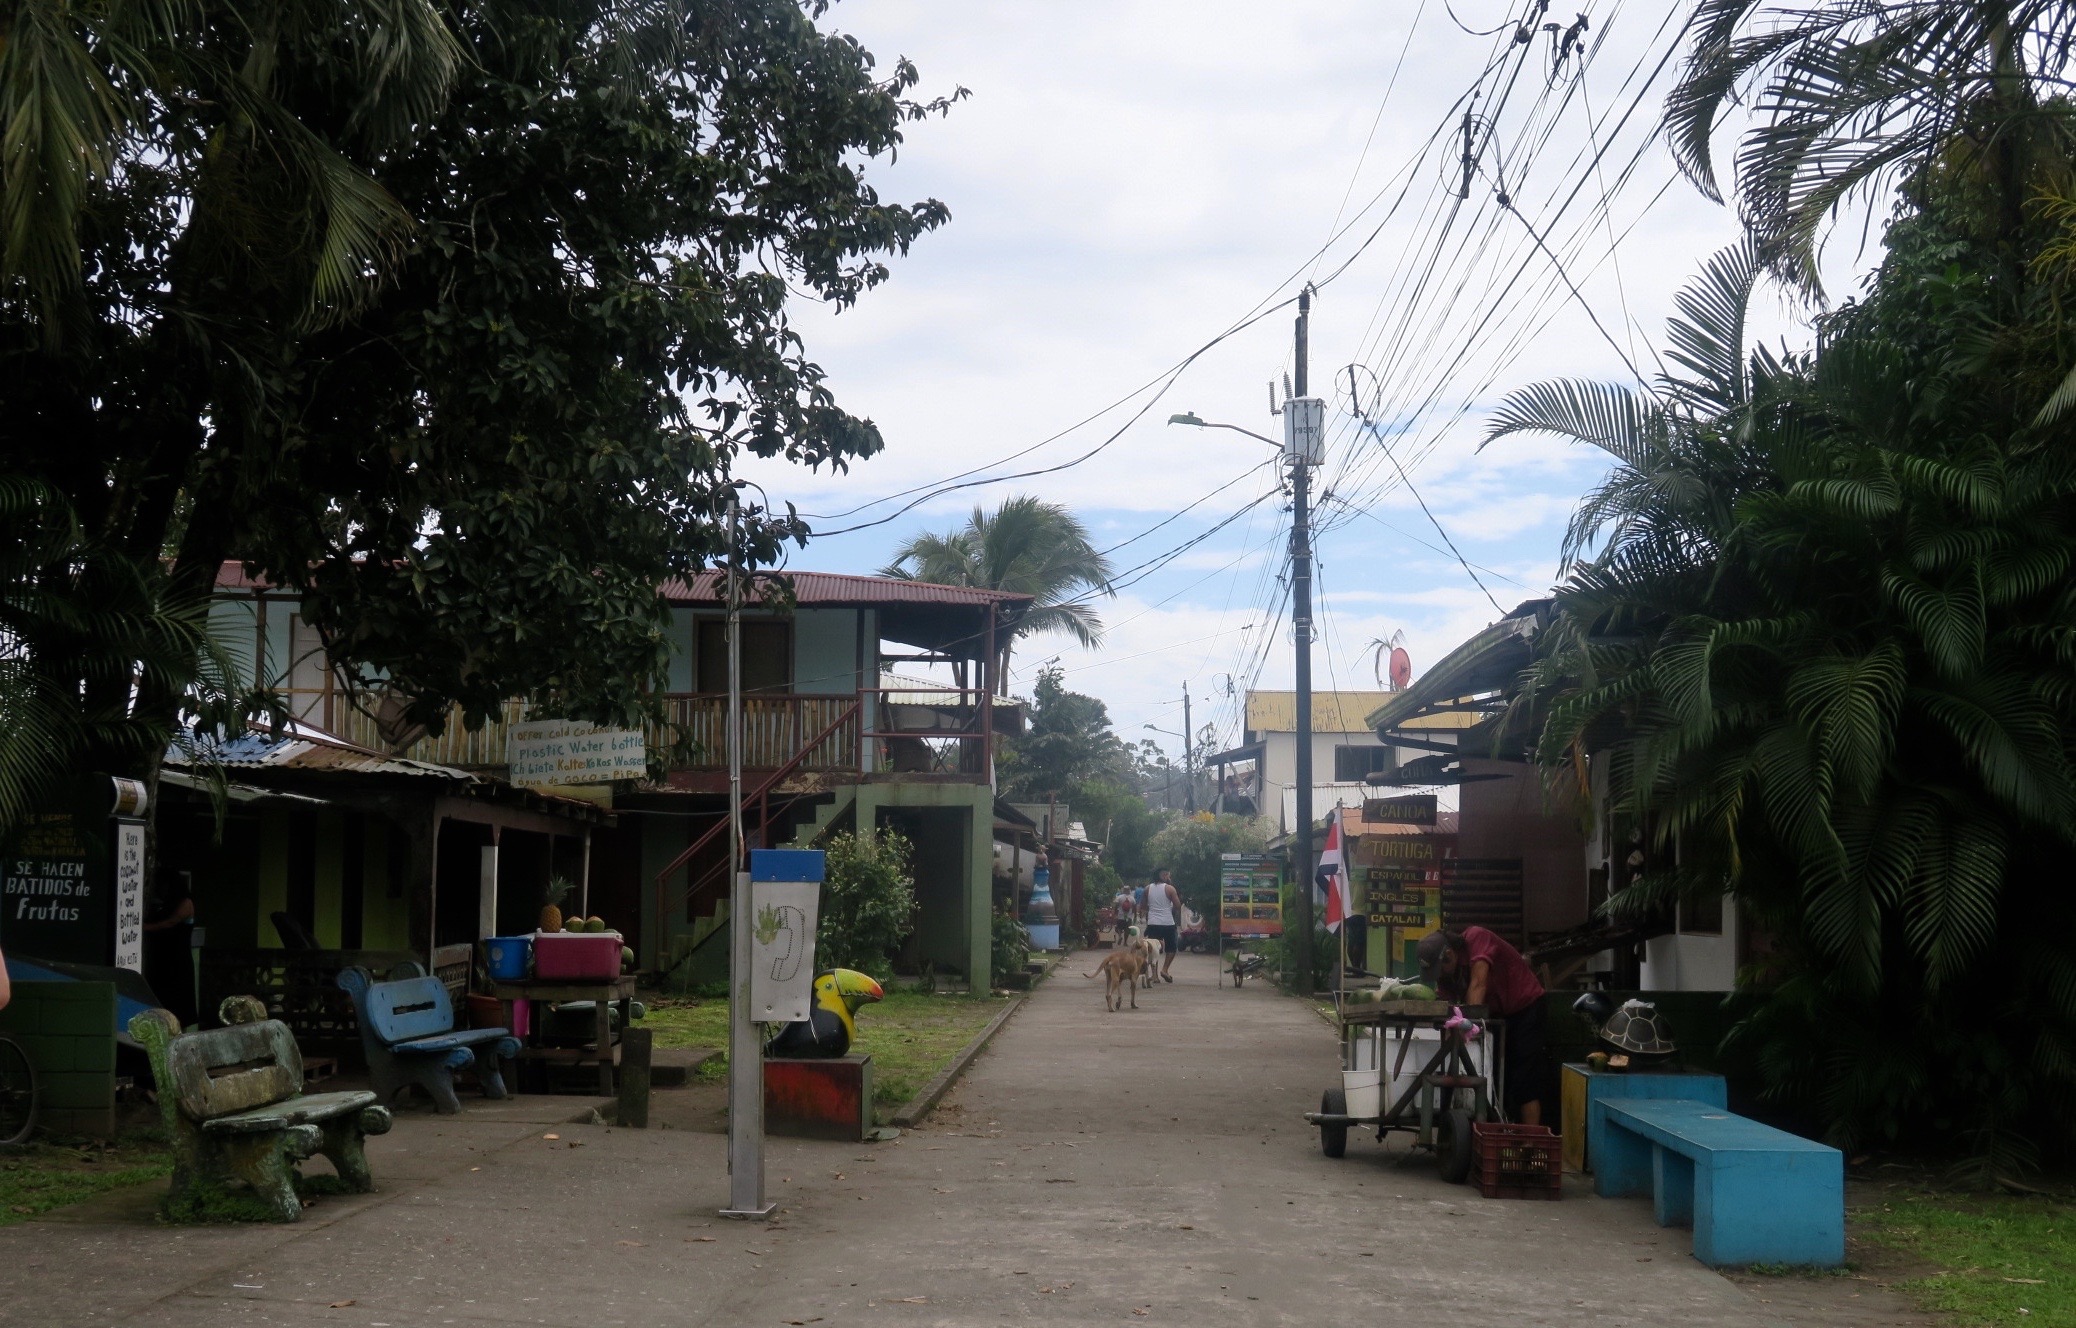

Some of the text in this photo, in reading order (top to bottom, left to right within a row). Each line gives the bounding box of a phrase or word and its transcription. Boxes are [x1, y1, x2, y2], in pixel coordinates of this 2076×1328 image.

[569, 741, 604, 754] Water
[1371, 840, 1433, 859] TORTUGA
[15, 861, 85, 877] SE HACEN
[5, 877, 91, 897] BATIDOS de
[1369, 892, 1419, 903] INGLES
